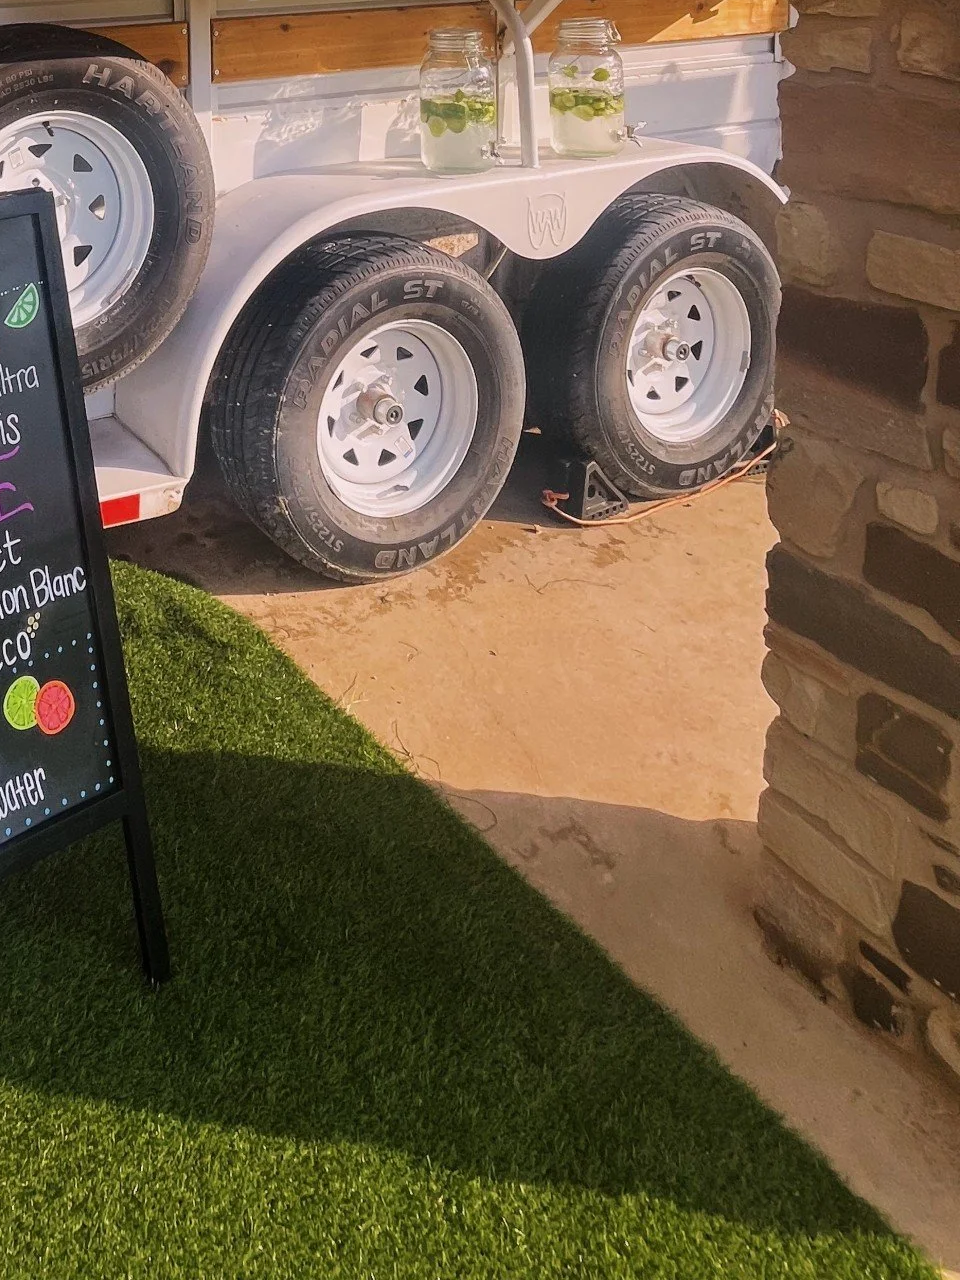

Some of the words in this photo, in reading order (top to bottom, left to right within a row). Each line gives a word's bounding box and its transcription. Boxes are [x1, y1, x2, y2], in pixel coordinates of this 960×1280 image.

[83, 64, 202, 244] HARTLAND
[690, 231, 722, 251] ST
[293, 291, 389, 410] RADIAL
[403, 279, 444, 299] ST
[30, 565, 87, 608] Blanc
